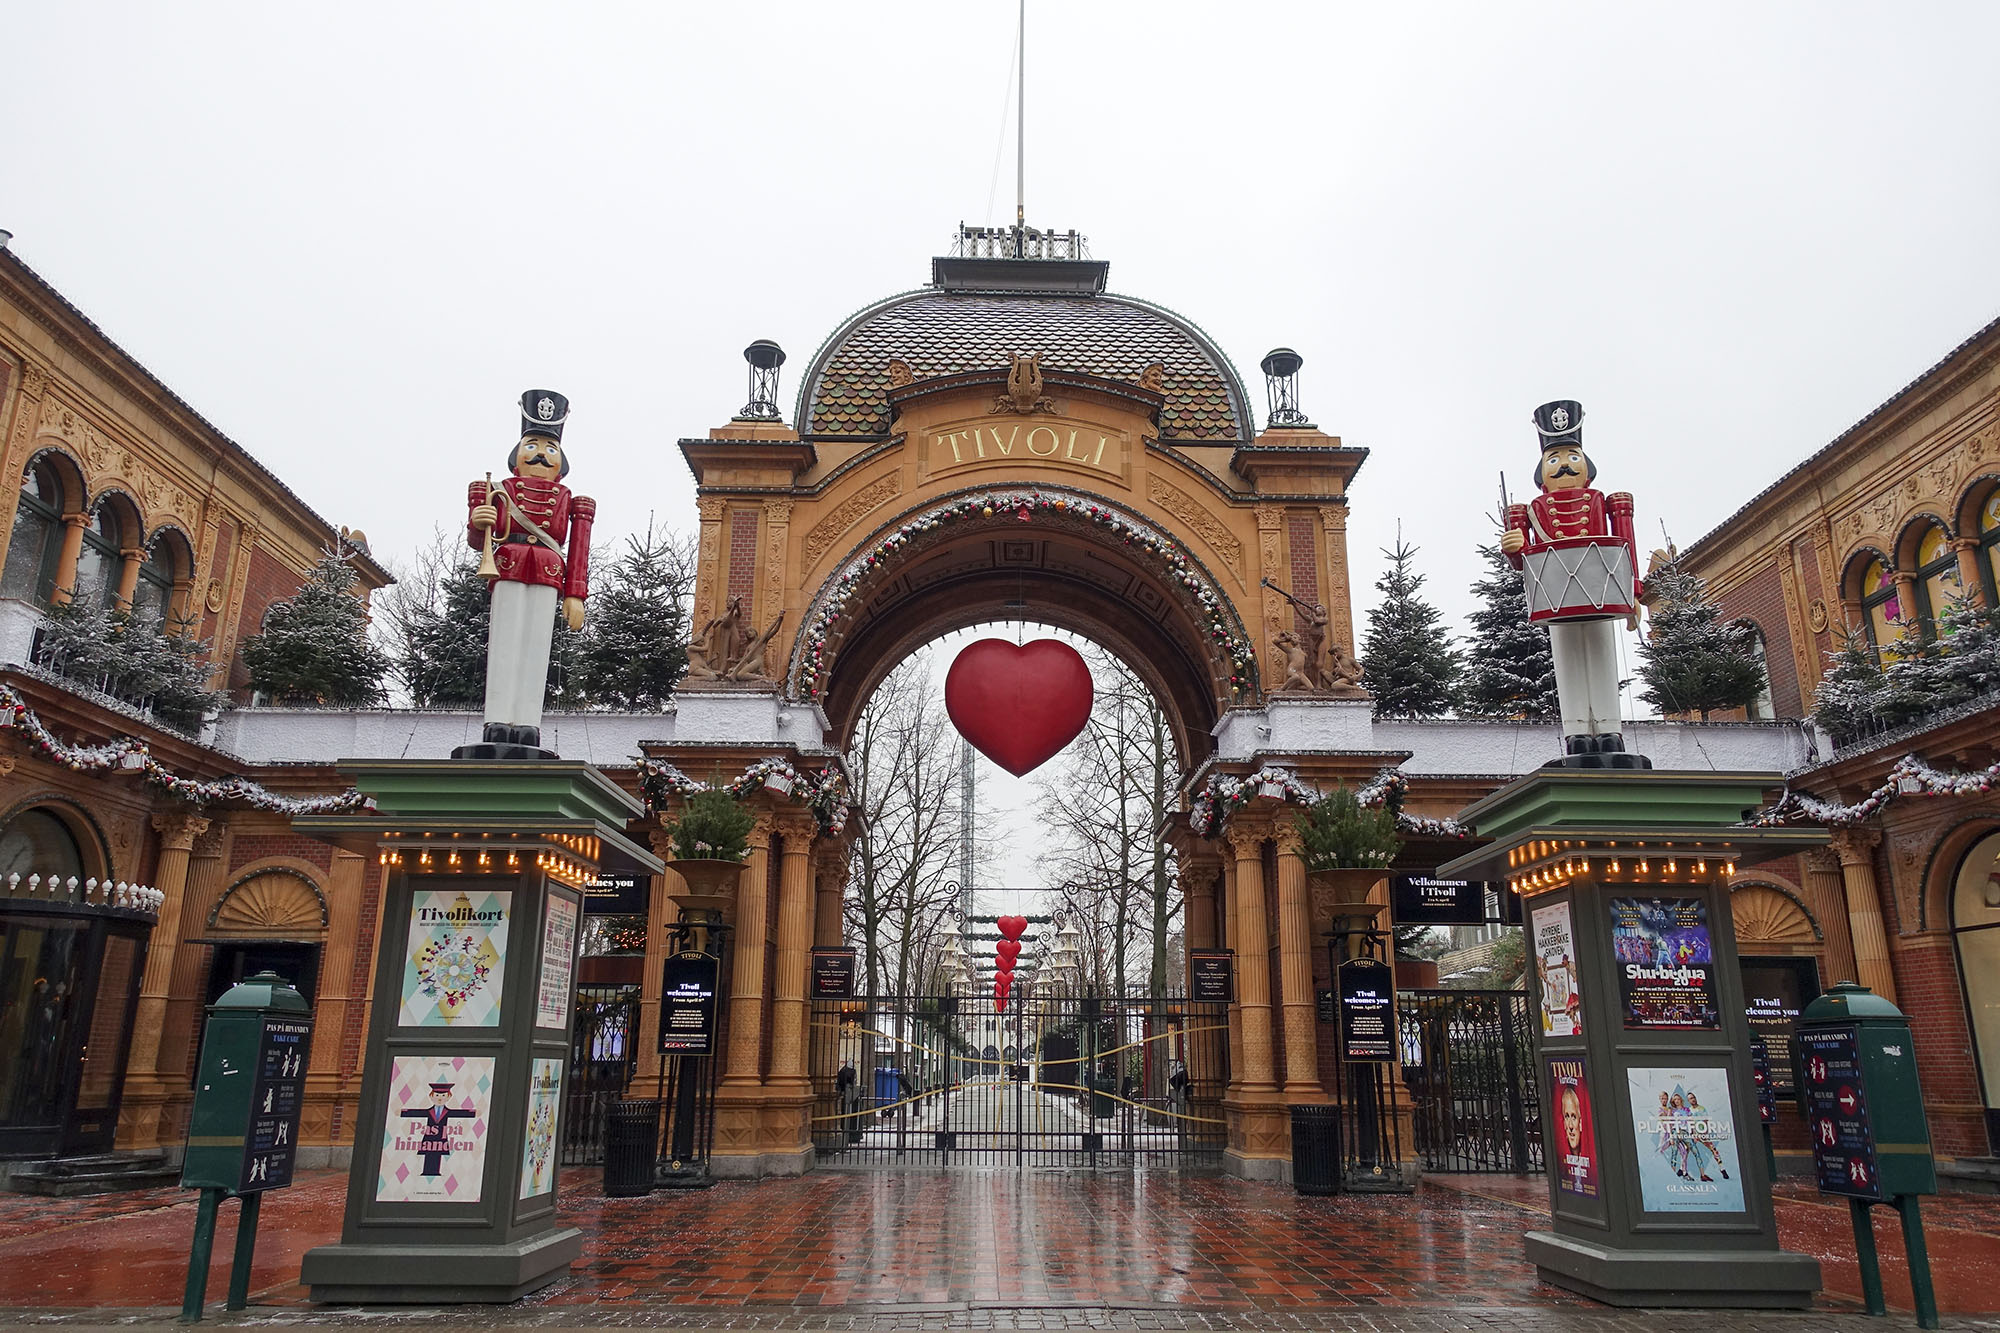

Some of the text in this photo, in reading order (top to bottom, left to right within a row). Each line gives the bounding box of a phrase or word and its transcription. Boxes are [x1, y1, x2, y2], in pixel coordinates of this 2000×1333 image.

[965, 226, 1076, 260] TIVOLI
[936, 425, 1107, 466] TIVOLI
[615, 880, 634, 889] you
[1408, 877, 1468, 887] Velkommen
[1426, 887, 1456, 896] Tivoli
[418, 908, 504, 921] Tivolikort
[1674, 977, 1703, 987] 2022
[1754, 998, 1780, 1006] Tivoli
[1745, 1008, 1799, 1018] elcomes you
[266, 1024, 276, 1032] PAS
[277, 1023, 284, 1032] PÅ
[1804, 1034, 1814, 1042] PAS
[1814, 1033, 1822, 1041] PÅ
[1551, 1062, 1583, 1078] TIVOLI
[410, 1121, 464, 1140] Pas på
[1638, 1120, 1732, 1134] PLATT-FORM
[394, 1137, 475, 1152] hinanden
[1666, 1184, 1718, 1193] GLASSALEN
